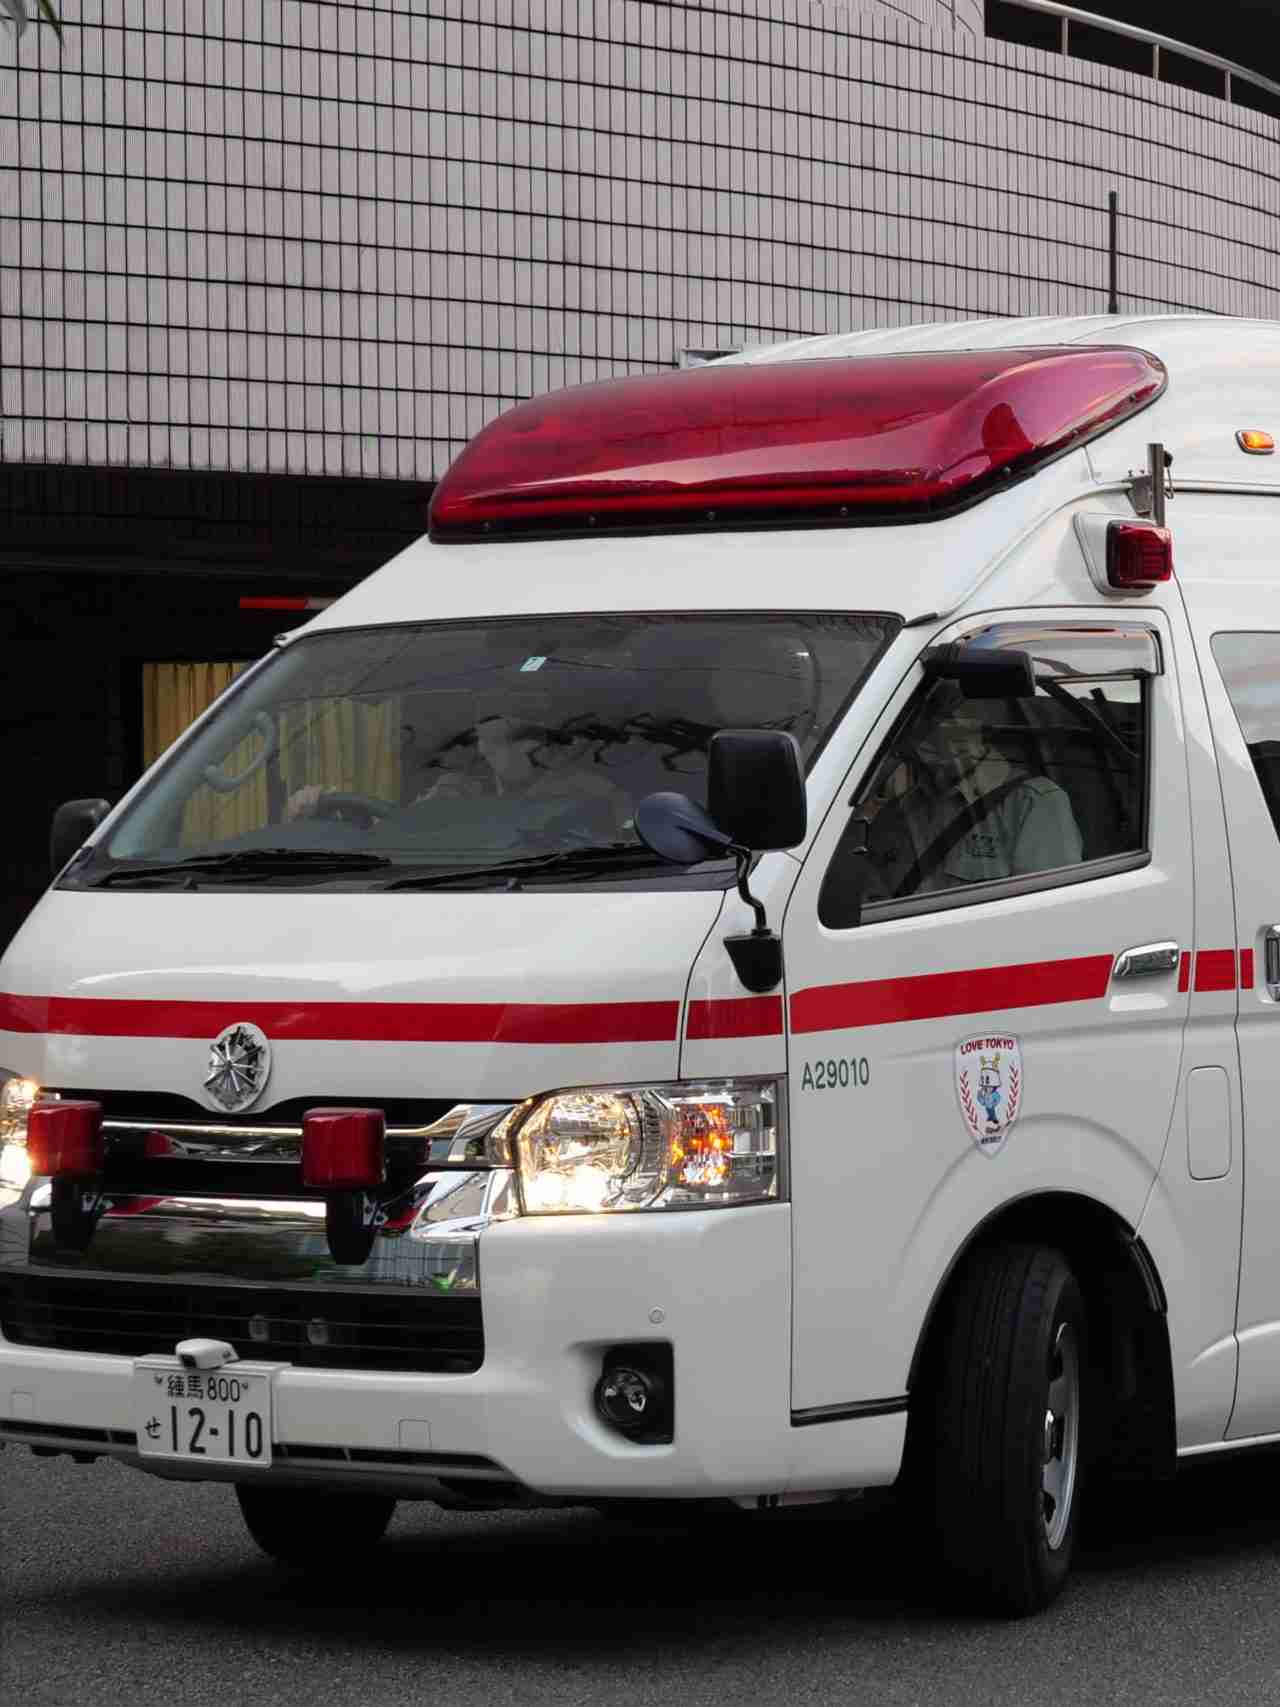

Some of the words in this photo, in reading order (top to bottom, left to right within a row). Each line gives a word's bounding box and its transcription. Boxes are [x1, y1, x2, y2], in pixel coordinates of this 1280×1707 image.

[960, 1040, 983, 1055] LOVE
[985, 1038, 1014, 1050] TOKYO
[801, 1056, 870, 1091] A29010
[207, 1376, 241, 1403] 800
[144, 1416, 161, 1439] せ
[171, 1405, 263, 1459] 12-10
